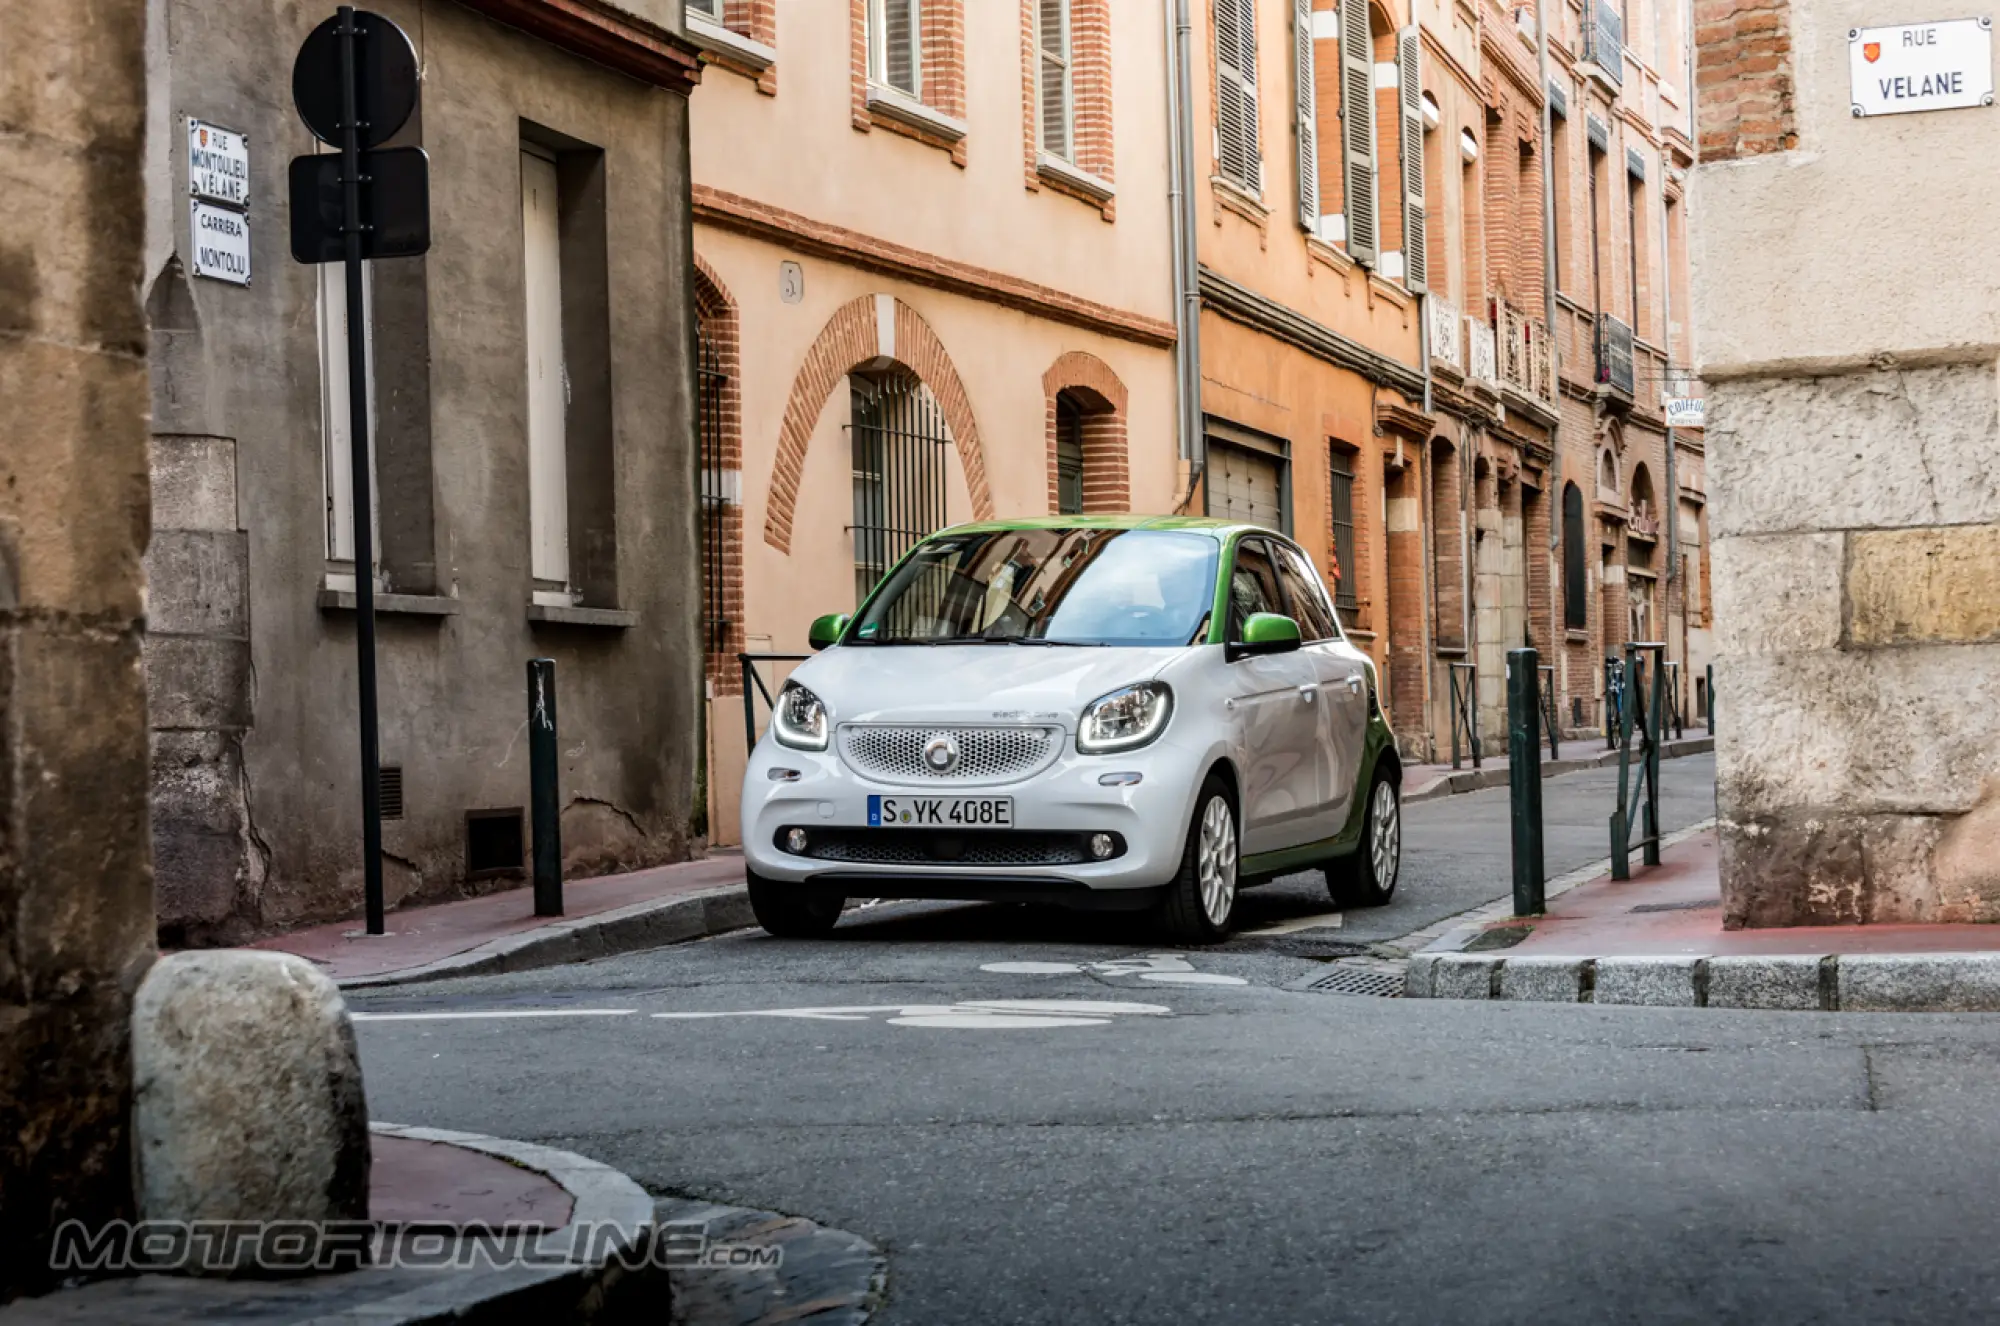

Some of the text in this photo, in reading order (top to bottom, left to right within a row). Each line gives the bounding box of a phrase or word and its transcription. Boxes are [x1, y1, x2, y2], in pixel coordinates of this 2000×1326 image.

[1903, 28, 1936, 47] RUE
[1879, 71, 1963, 99] VELANE
[212, 132, 228, 150] RUE
[883, 799, 1010, 824] S YK 408E
